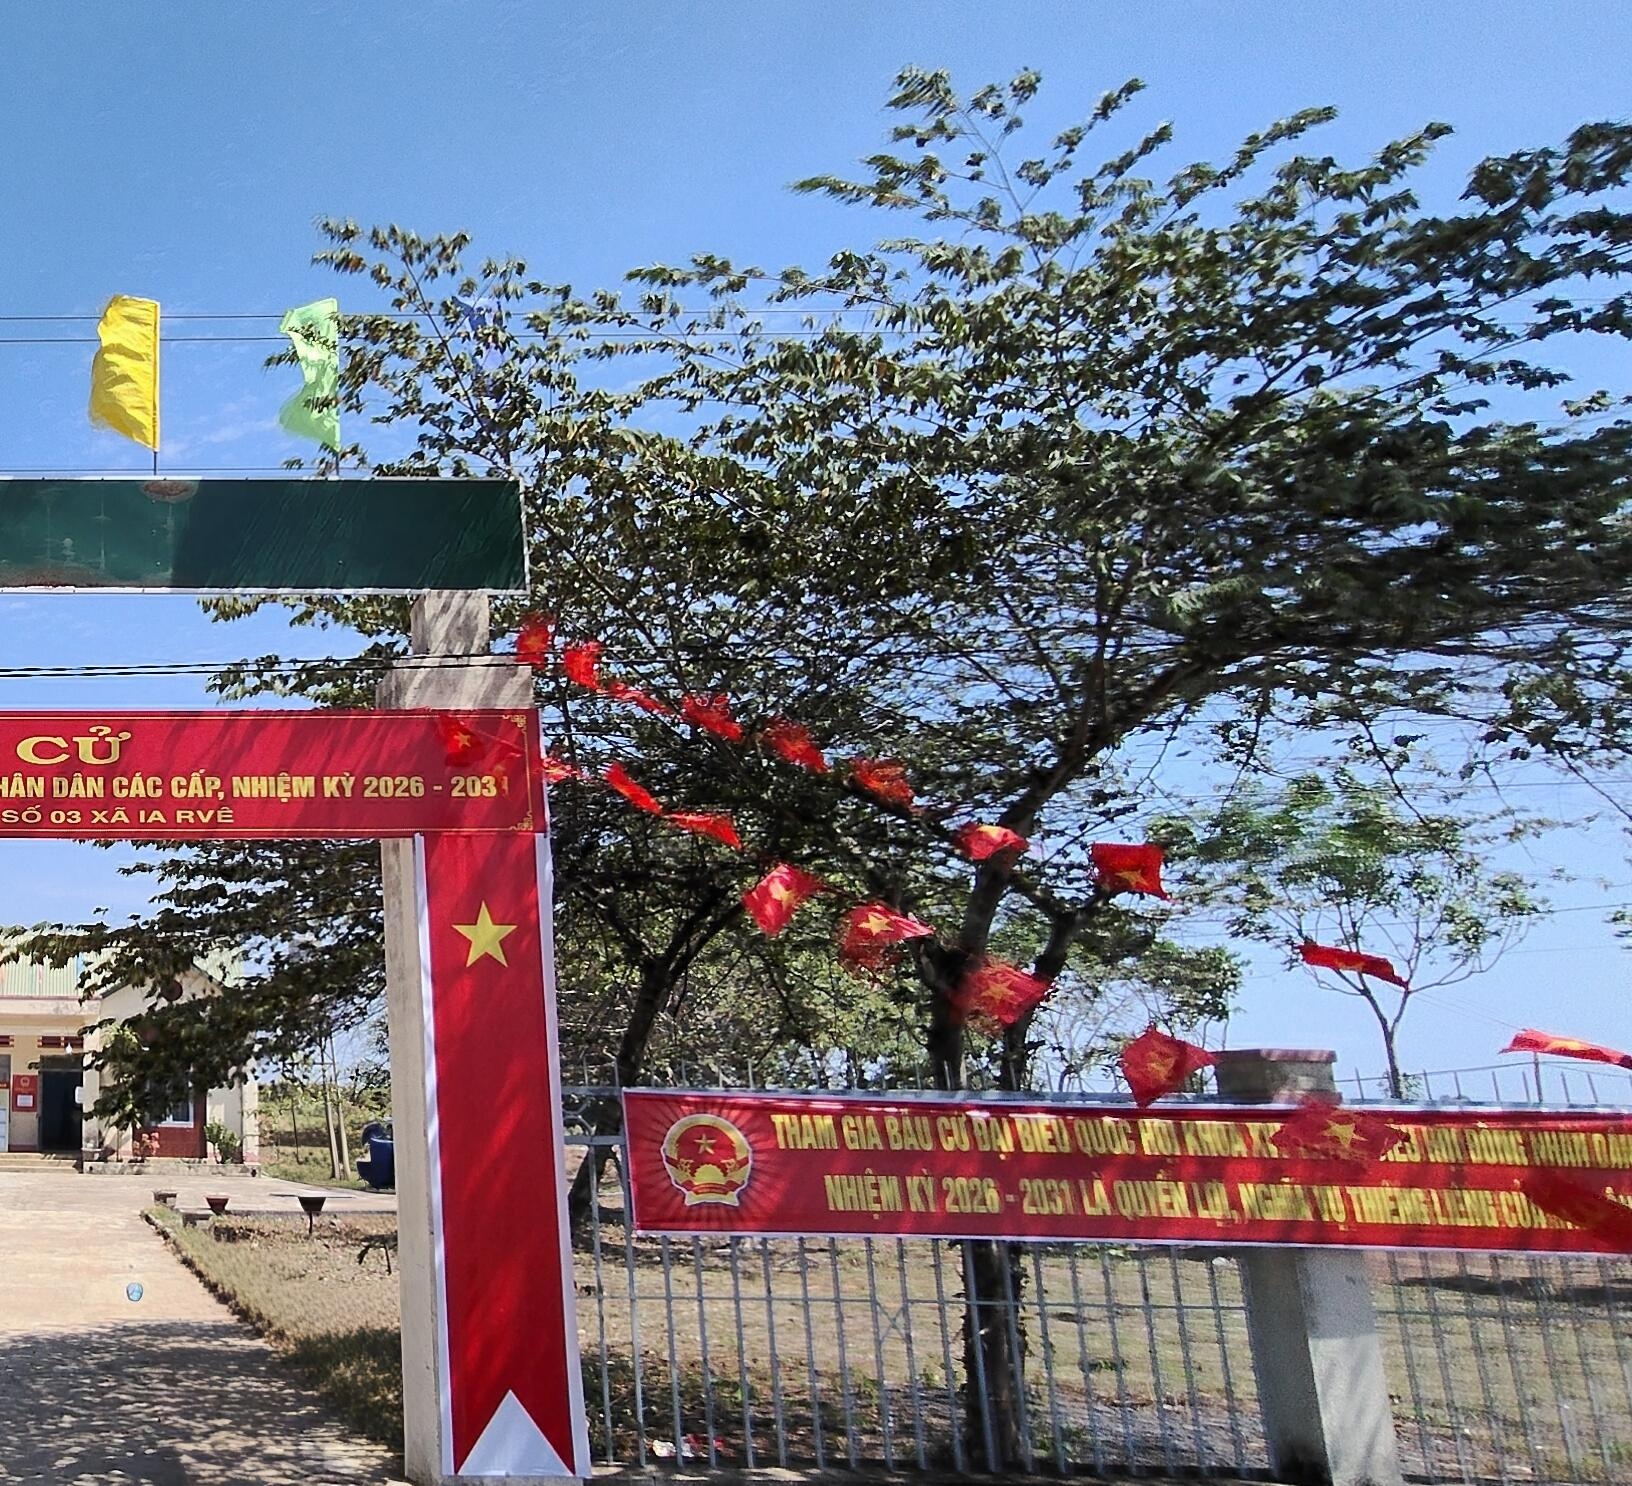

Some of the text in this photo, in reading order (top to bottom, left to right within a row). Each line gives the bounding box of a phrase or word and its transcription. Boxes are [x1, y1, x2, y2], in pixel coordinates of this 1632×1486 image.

[16, 725, 131, 766] CỬ
[53, 771, 105, 799] DÂN
[112, 769, 163, 799] CÁC
[170, 768, 225, 801] CẤP,
[232, 771, 315, 803] NHIỆM
[323, 770, 354, 798] KỲ
[363, 776, 425, 798] 2026
[1, 802, 43, 825] SỐ
[51, 810, 82, 825] 03
[91, 806, 130, 824] XÃ
[139, 809, 168, 824] IA
[176, 805, 235, 824] RVÊ
[770, 1113, 839, 1150] THAM
[841, 1114, 884, 1150] GIA
[971, 1115, 1015, 1160] ĐẠI
[824, 1168, 904, 1220] NHIỆM
[905, 1168, 937, 1213] KỲ
[941, 1176, 1002, 1214] 2026
[1018, 1177, 1075, 1215] 2031
[1079, 1171, 1112, 1216] LÀ
